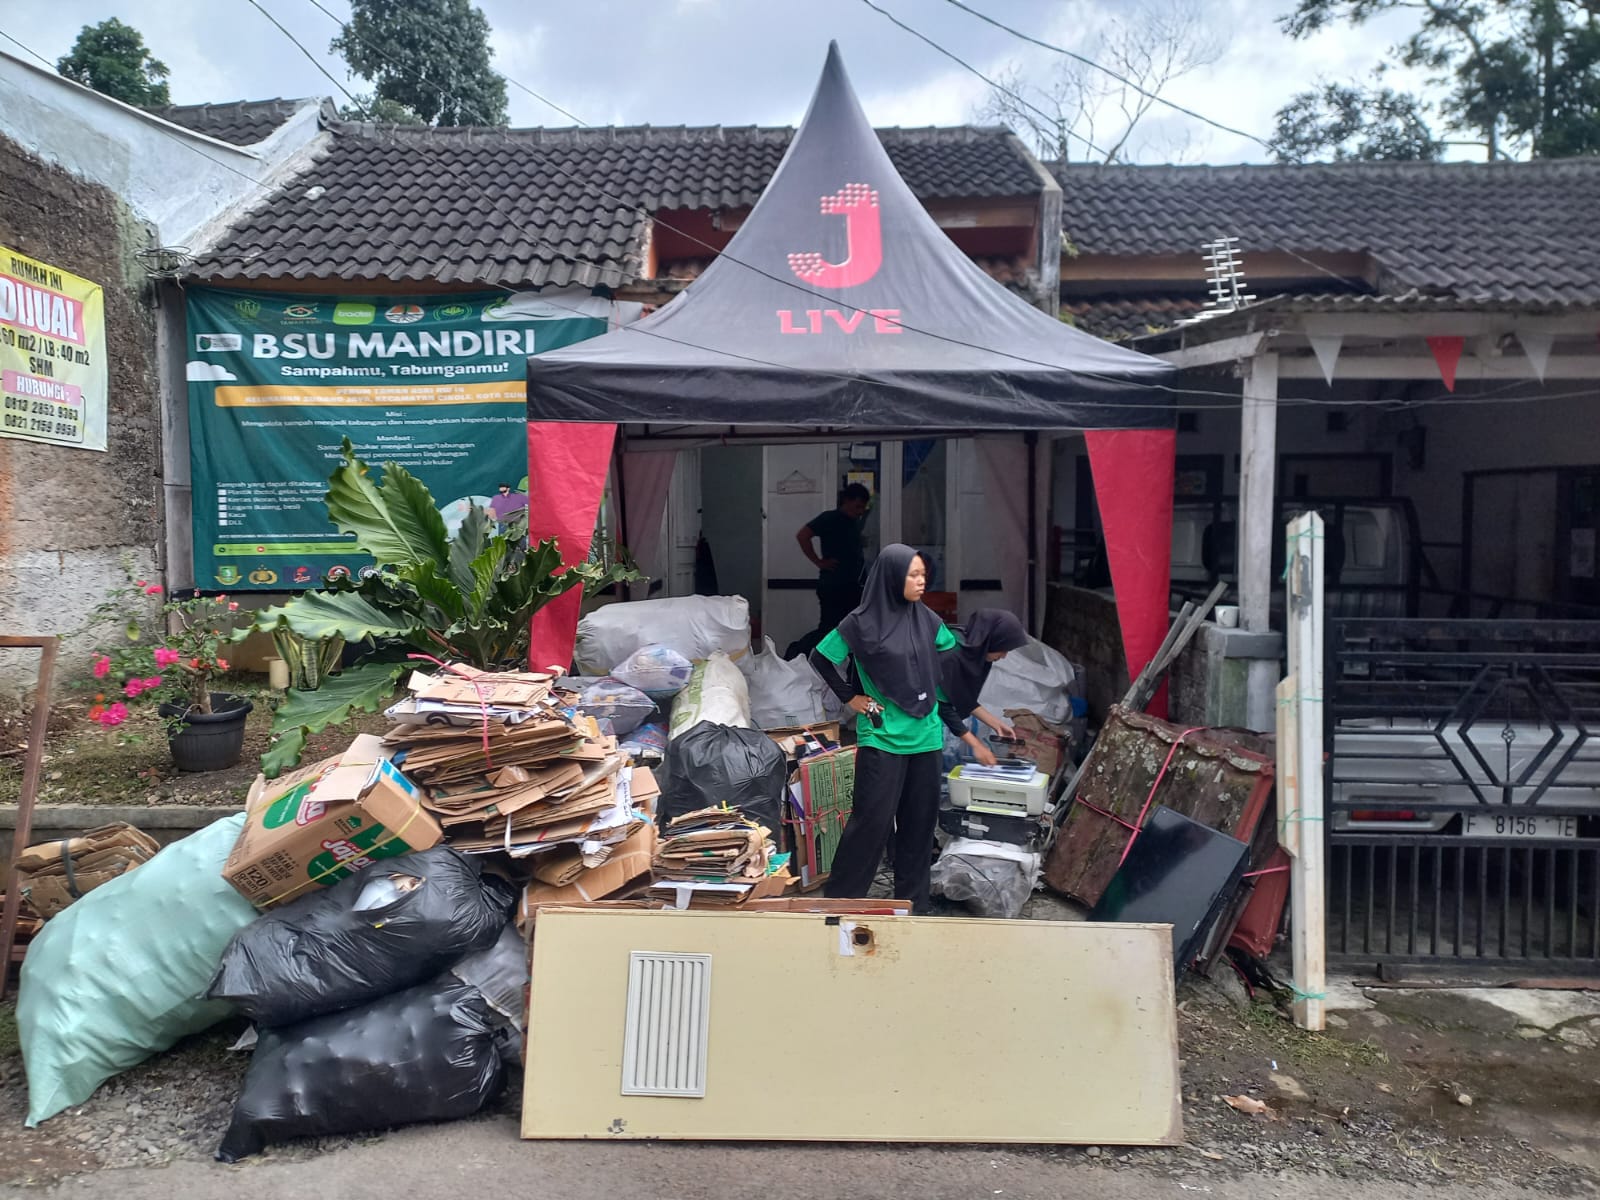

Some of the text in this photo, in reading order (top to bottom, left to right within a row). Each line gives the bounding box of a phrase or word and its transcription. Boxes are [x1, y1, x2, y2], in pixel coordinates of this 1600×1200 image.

[787, 183, 882, 289] J
[10, 257, 63, 291] RUMAH INI
[0, 277, 78, 341] DIJUAL
[776, 309, 903, 334] LIVE
[253, 329, 535, 359] BSU MANDIRI
[29, 356, 54, 377] SHM
[281, 362, 509, 378] Sampahmu, Tabunganmu!
[1467, 815, 1476, 833] F
[1495, 816, 1537, 836] 8156
[240, 873, 258, 891] gram
[247, 867, 269, 886] 120
